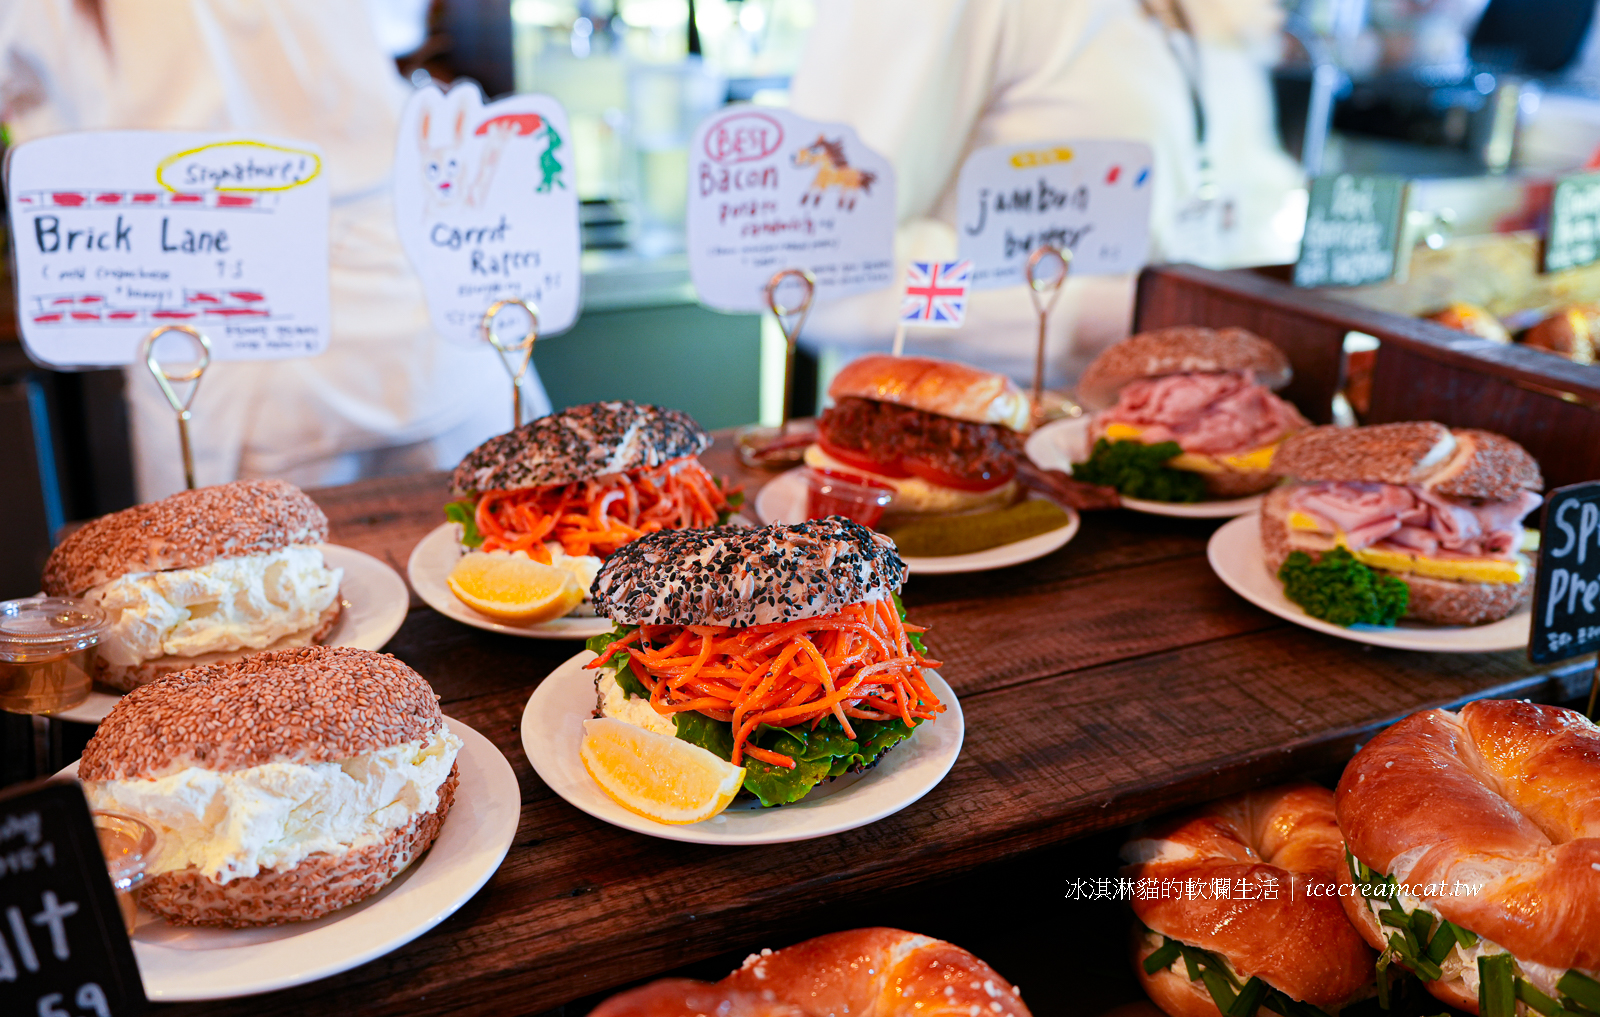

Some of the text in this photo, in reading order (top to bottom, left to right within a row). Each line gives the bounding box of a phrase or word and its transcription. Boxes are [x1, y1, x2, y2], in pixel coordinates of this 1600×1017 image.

[716, 126, 769, 160] BEST
[699, 162, 779, 198] Bacon
[34, 214, 231, 254] Brick Lane
[1551, 498, 1600, 566] Sp
